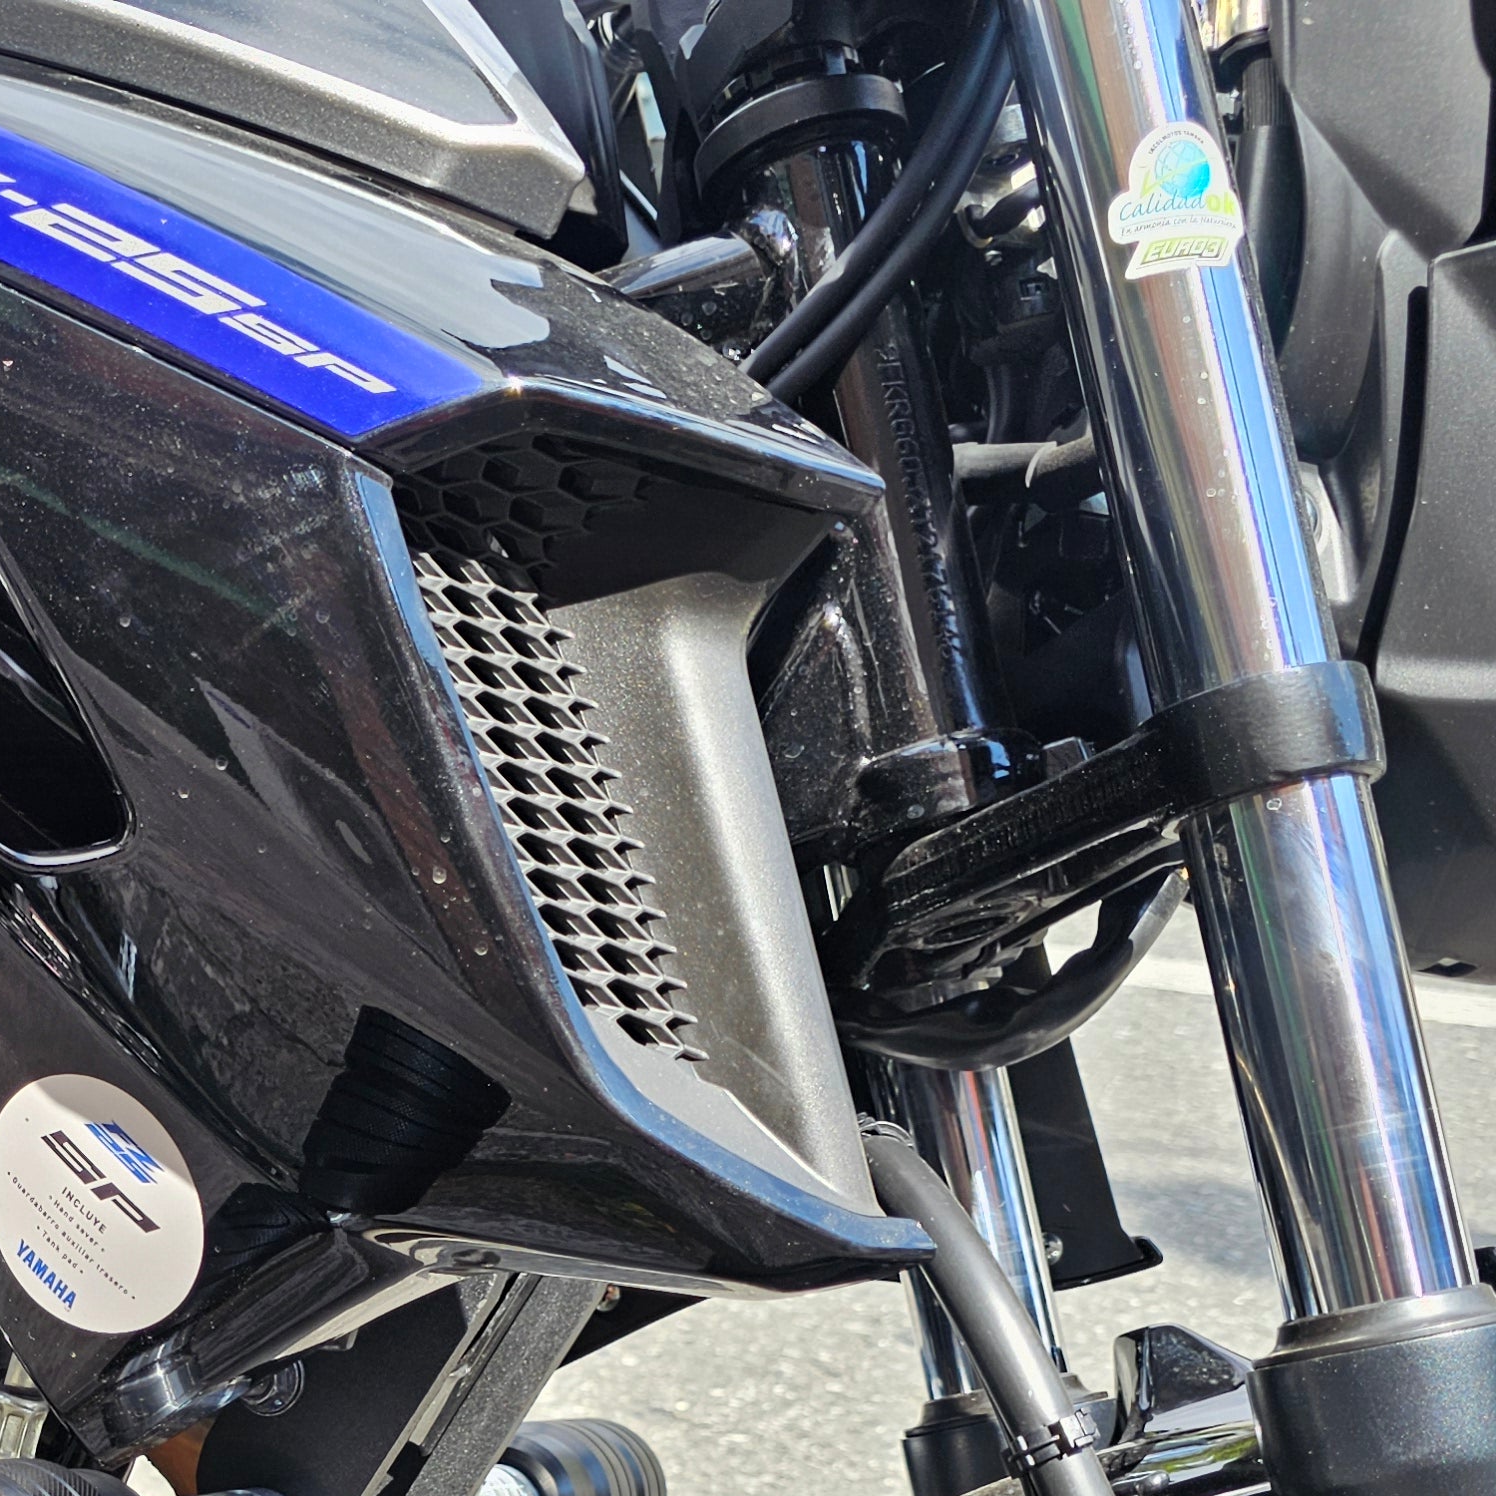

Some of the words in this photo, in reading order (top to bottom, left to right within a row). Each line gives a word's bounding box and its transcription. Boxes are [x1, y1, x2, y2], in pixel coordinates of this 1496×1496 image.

[1119, 188, 1205, 221] Calidad
[40, 1129, 161, 1234] SP
[53, 1199, 75, 1223] Hand
[75, 1223, 99, 1247] saver
[61, 1186, 108, 1235] INCLUYE
[12, 1176, 60, 1230] Guardabarro
[61, 1230, 95, 1263] auxiliar
[96, 1263, 129, 1295] trasero
[42, 1228, 61, 1252] Tank
[61, 1252, 78, 1270] pad
[16, 1238, 77, 1310] YAMAHA
